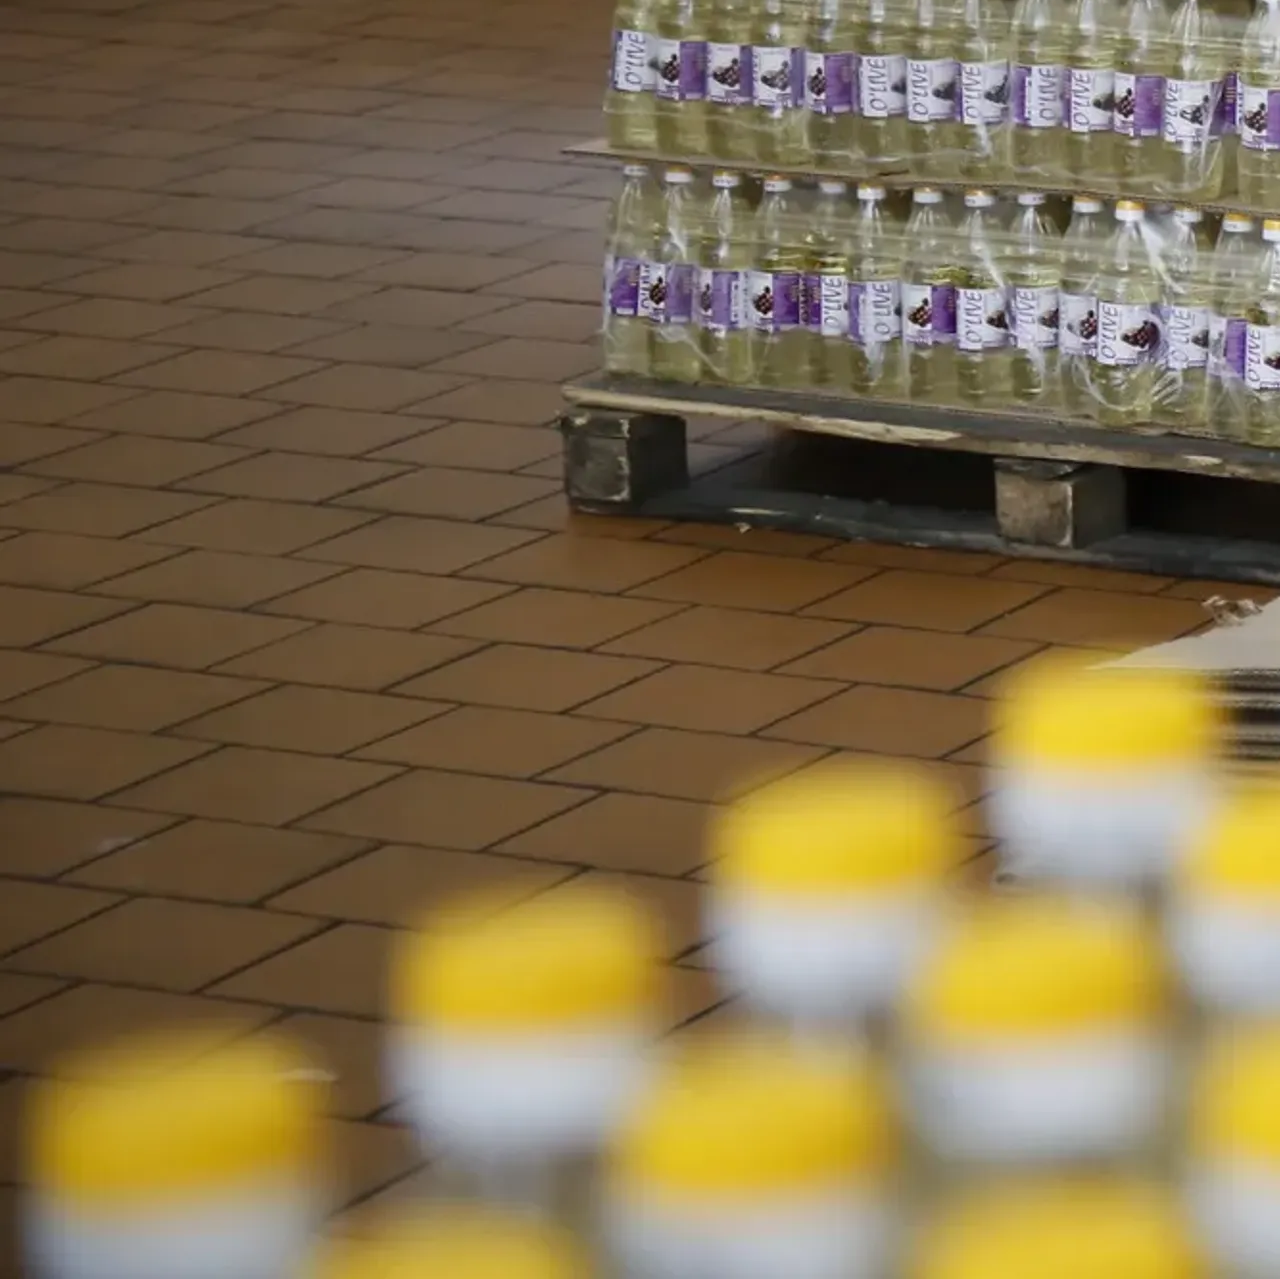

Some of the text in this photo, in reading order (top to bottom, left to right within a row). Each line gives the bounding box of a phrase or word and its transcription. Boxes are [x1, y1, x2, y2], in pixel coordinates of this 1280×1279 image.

[624, 32, 646, 87] O'LIVE
[866, 57, 887, 112] O'LIVE
[911, 61, 929, 116] O'LIVE
[963, 65, 982, 120] O'LIVE
[1038, 66, 1057, 121] O'LIVE
[1073, 71, 1091, 127] O'LIVE
[823, 276, 842, 331] O'LIVE
[964, 291, 983, 344] O'LIVE
[1102, 304, 1119, 359] O'LIVE
